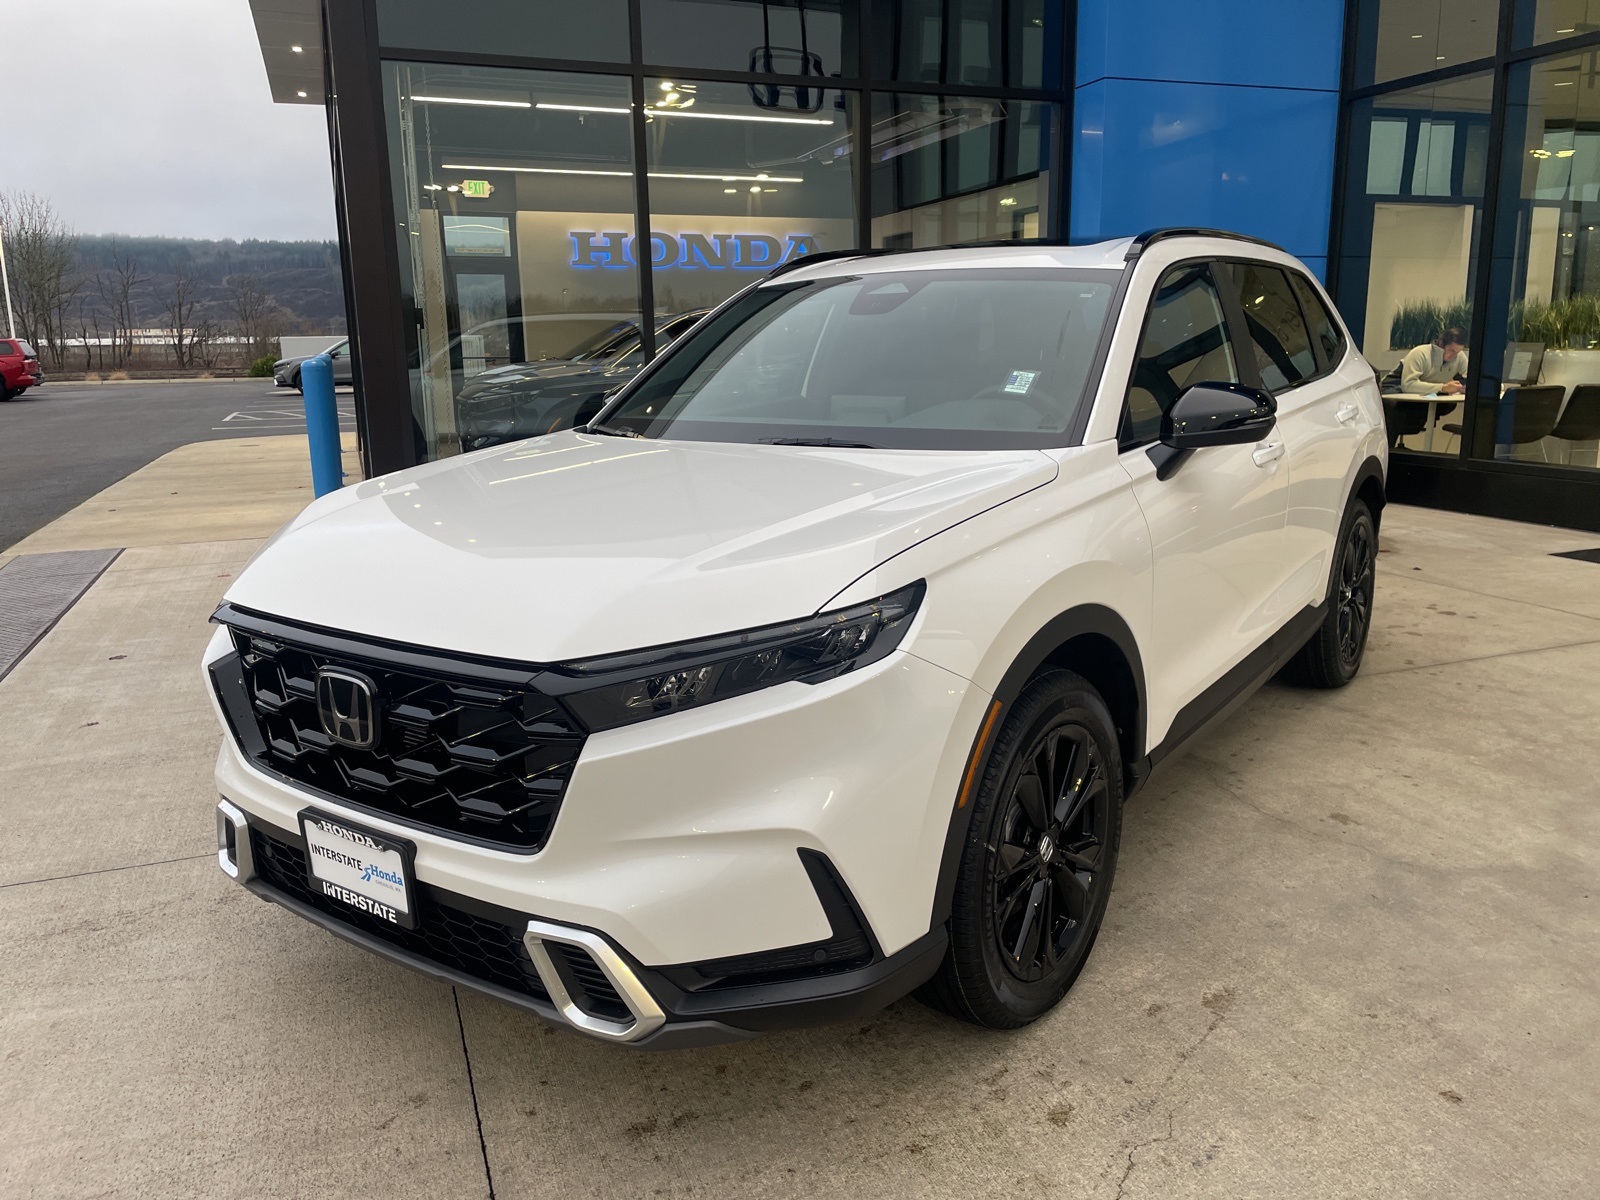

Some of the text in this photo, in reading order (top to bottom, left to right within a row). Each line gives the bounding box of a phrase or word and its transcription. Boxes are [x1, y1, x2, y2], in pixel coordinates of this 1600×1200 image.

[467, 181, 485, 195] EXIT
[569, 231, 819, 269] HONDA
[320, 820, 378, 850] HONDA
[311, 843, 363, 871] INTERSTATE
[369, 863, 403, 886] Honda
[322, 881, 397, 924] INTERSTATE
